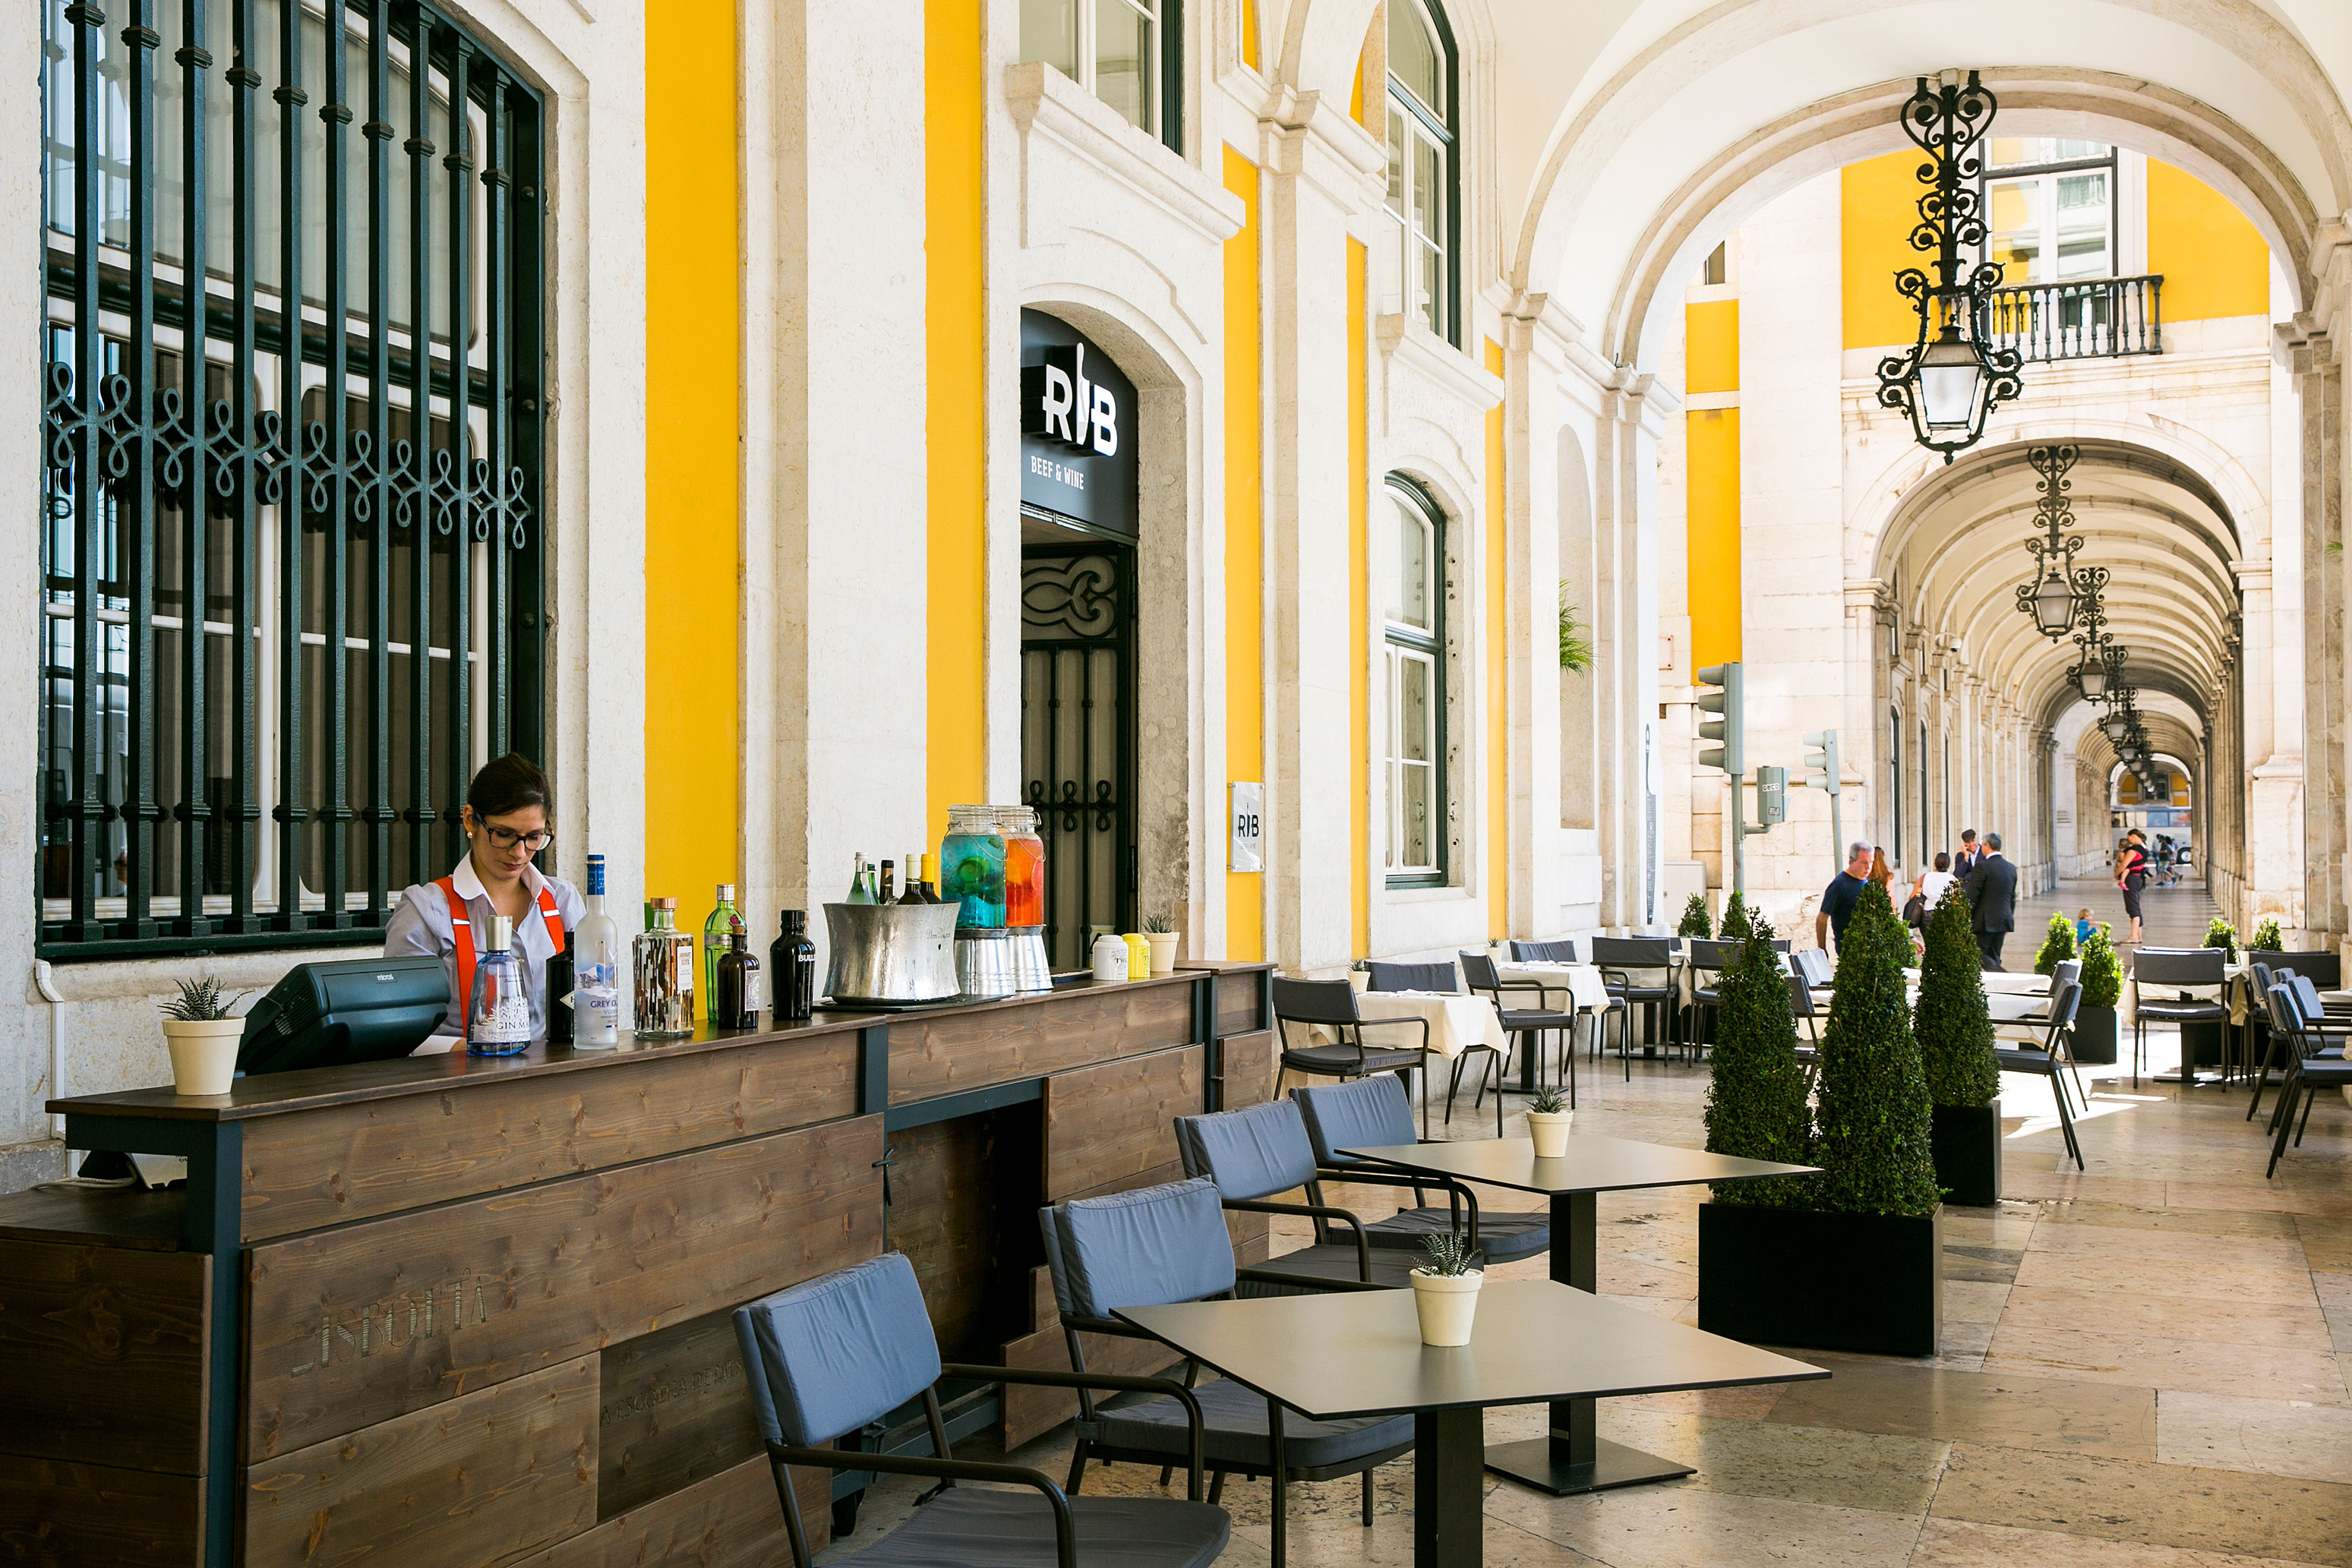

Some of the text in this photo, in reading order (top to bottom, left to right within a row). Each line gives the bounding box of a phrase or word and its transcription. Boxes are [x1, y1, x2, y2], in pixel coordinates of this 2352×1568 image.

[1042, 342, 1118, 457] RIB
[1031, 455, 1084, 491] BEEF & WINE
[1238, 803, 1259, 838] RIB
[590, 1000, 610, 1008] GREY
